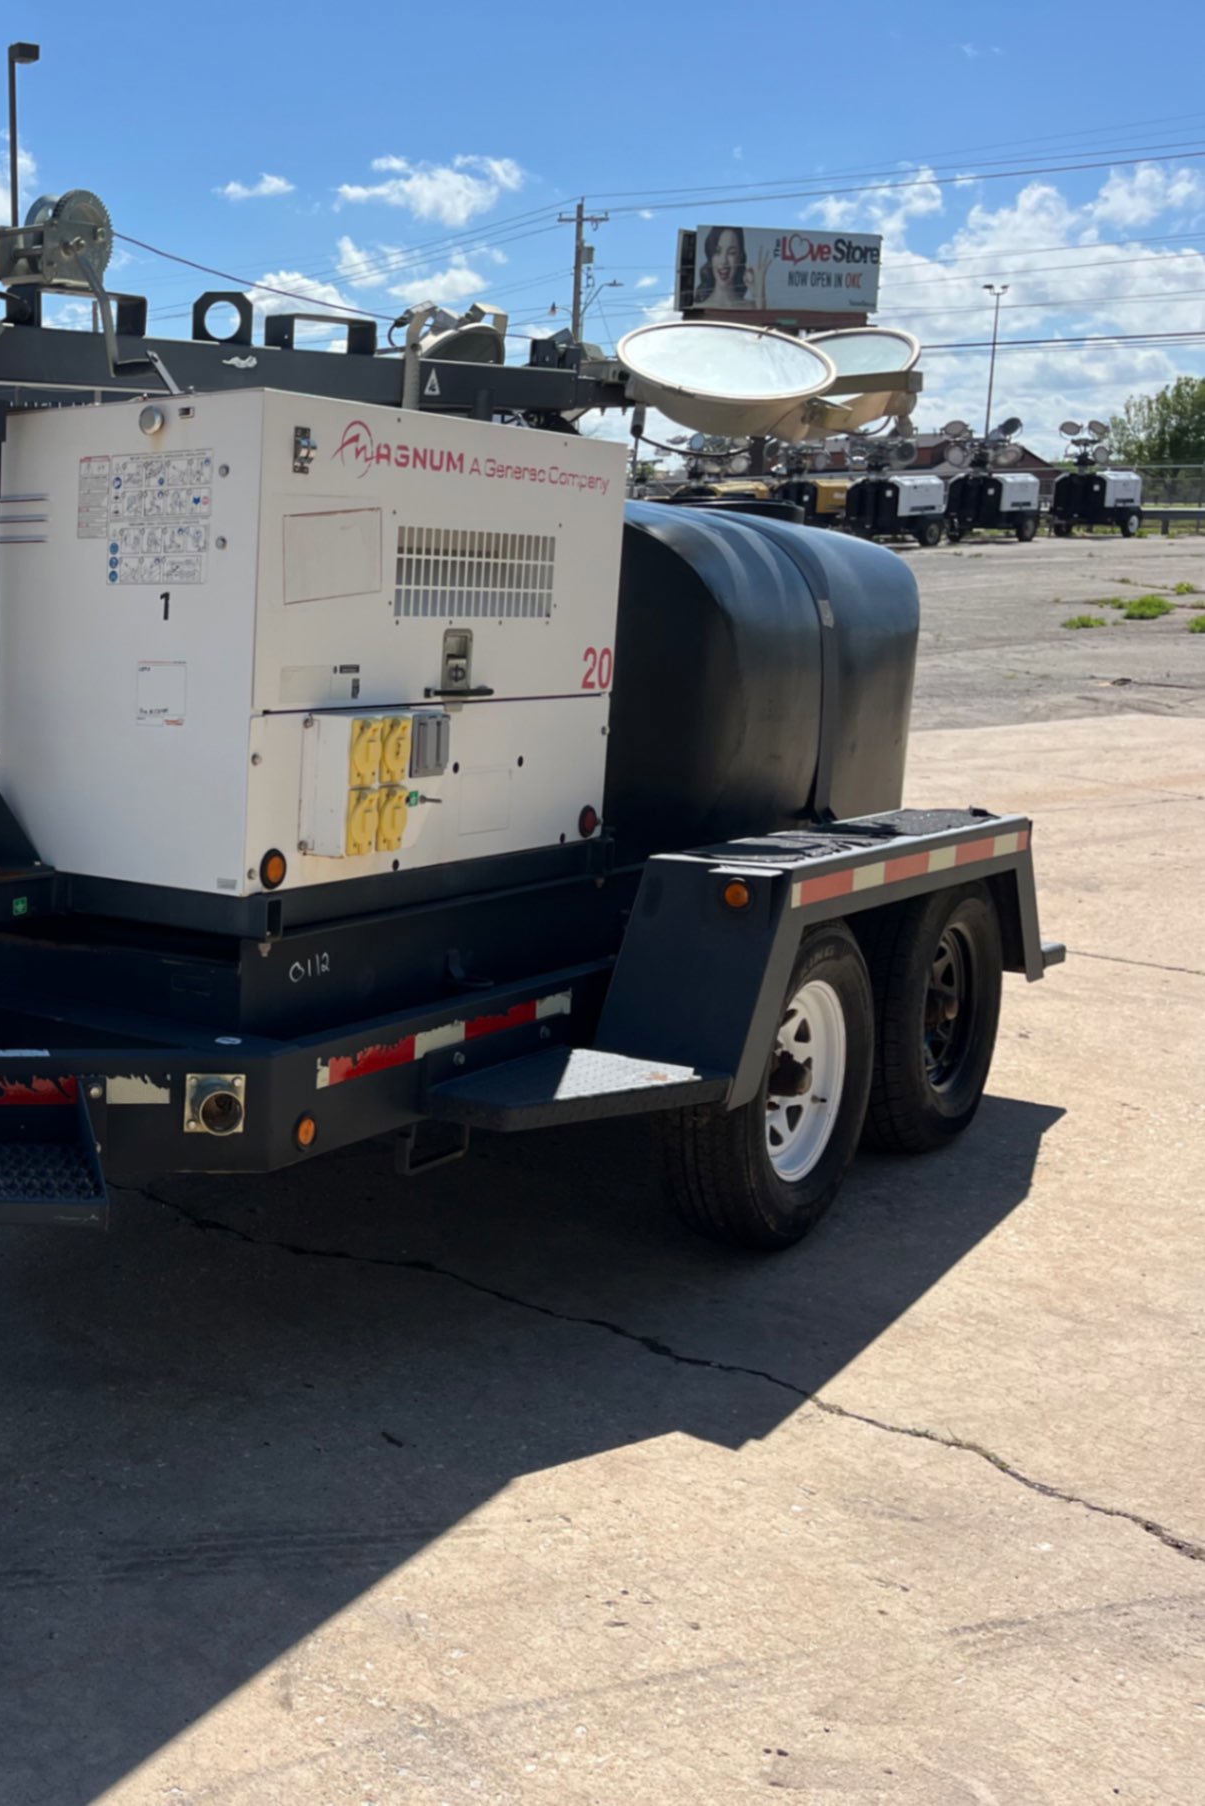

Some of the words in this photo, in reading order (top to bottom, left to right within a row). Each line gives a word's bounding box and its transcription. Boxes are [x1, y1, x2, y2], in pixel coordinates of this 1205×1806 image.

[781, 233, 831, 266] Love
[833, 238, 880, 265] Store
[787, 270, 808, 287] NOW
[810, 271, 832, 288] OPEN
[834, 272, 843, 288] IN
[469, 461, 481, 476] A
[484, 458, 546, 484] Generac
[548, 466, 610, 495] Company
[160, 592, 170, 621] 1
[581, 647, 613, 689] 20
